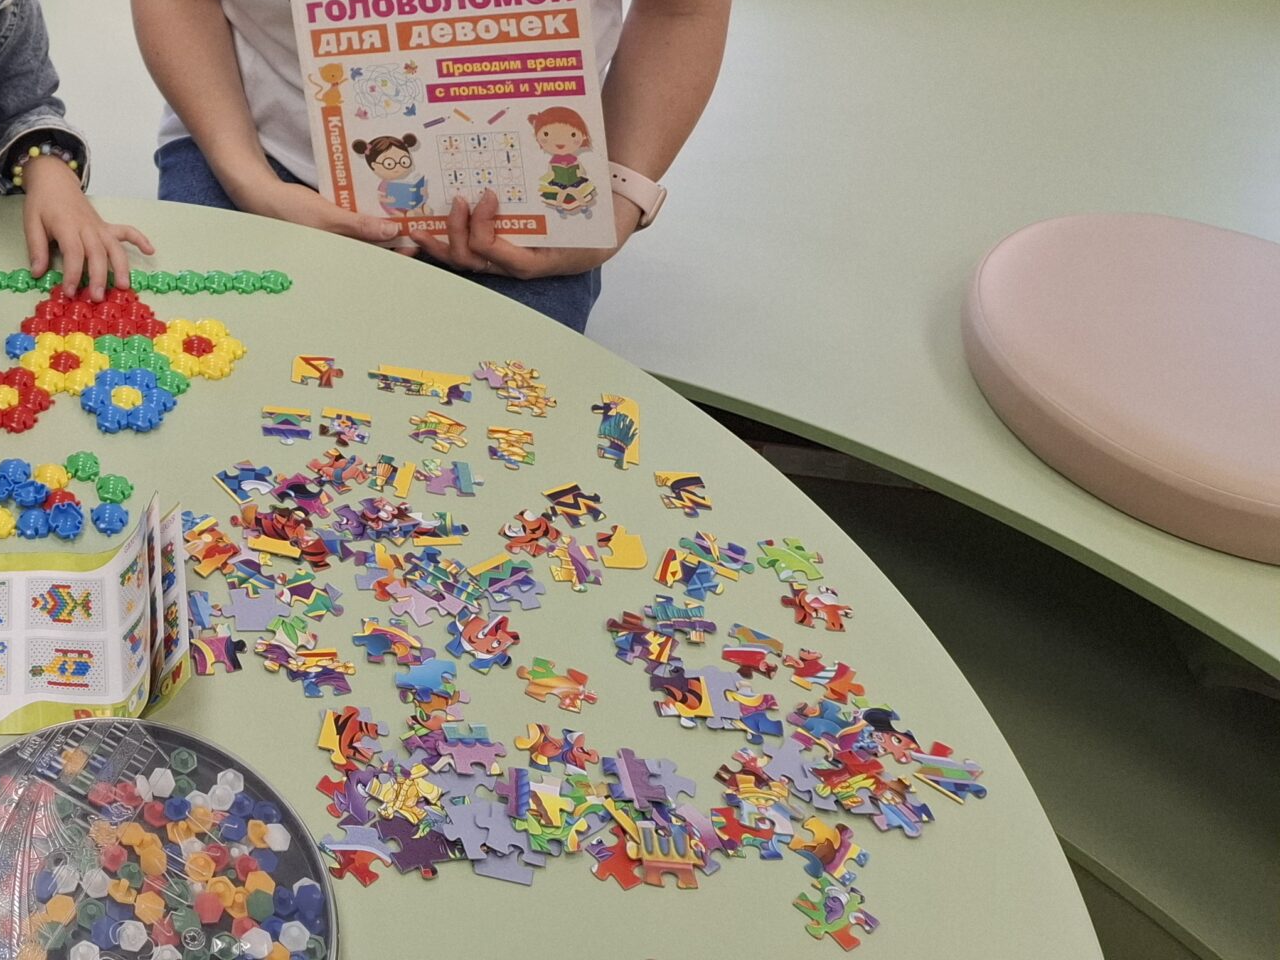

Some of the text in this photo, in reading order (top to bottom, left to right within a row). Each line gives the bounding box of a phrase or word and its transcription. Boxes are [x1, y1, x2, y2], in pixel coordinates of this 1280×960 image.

[318, 13, 570, 56] для девочек
[442, 56, 577, 76] Проводим время
[435, 80, 577, 98] с пользой и умом
[328, 116, 348, 186] Классная
